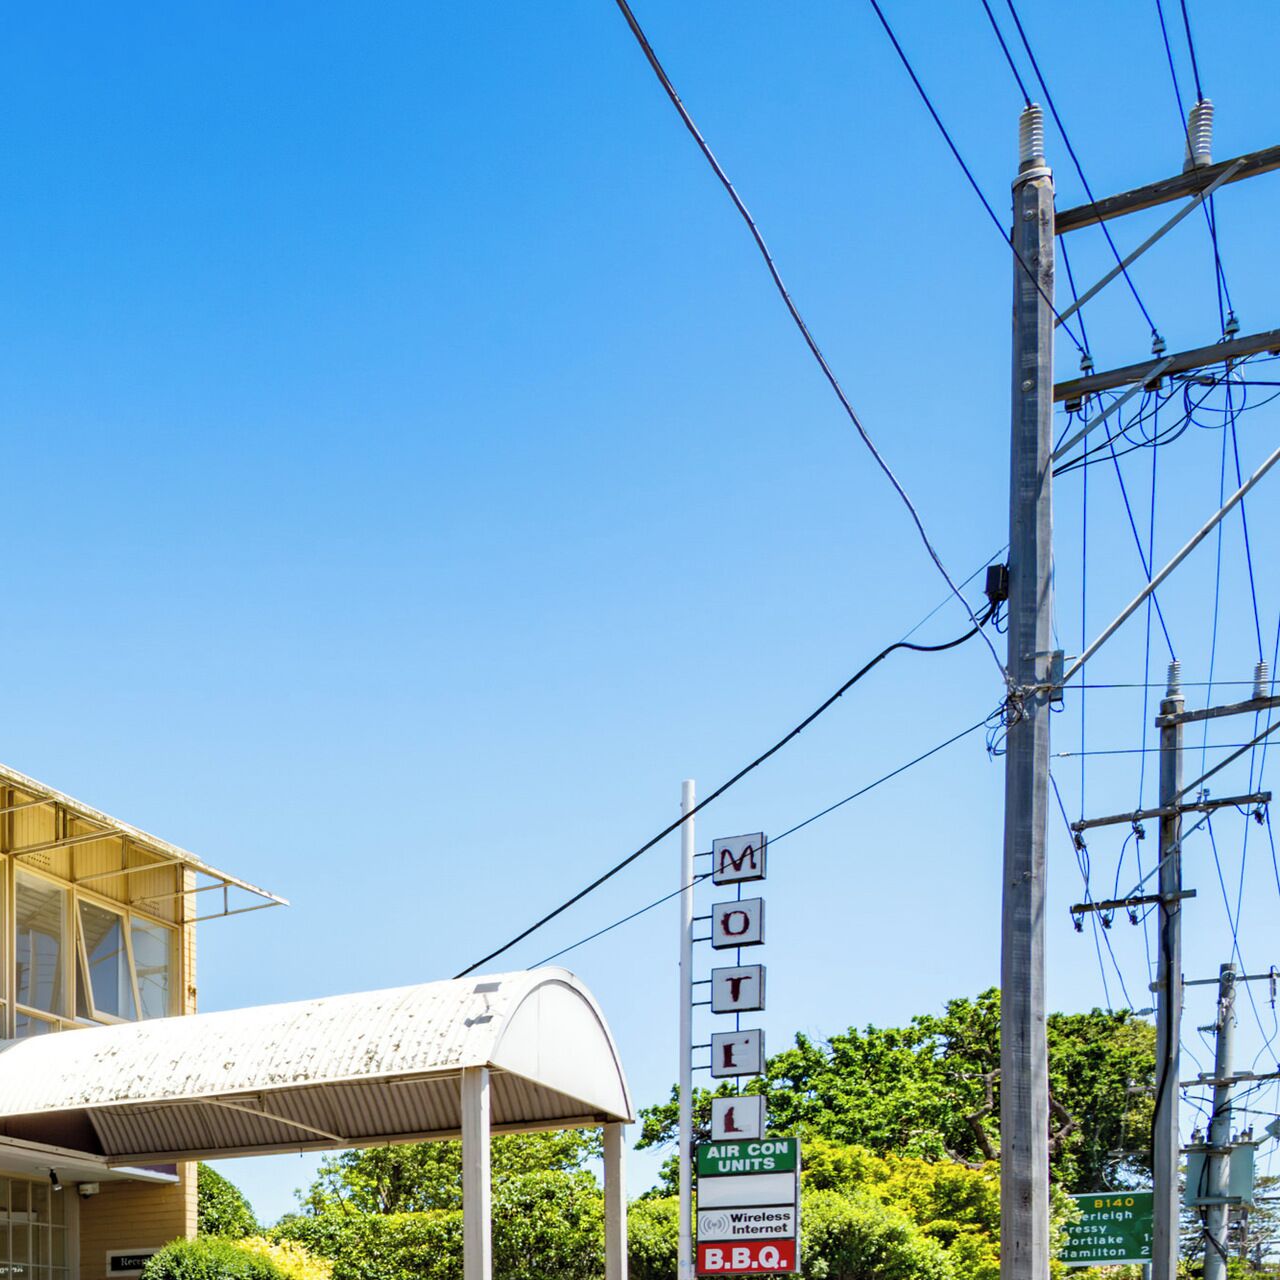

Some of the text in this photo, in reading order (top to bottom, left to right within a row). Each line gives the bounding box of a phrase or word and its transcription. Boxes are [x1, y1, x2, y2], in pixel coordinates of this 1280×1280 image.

[707, 1141, 788, 1159] AIR CON
[718, 1157, 775, 1172] UNITS
[1094, 1197, 1135, 1209] B140
[730, 1211, 791, 1223] Wireless
[1080, 1210, 1133, 1222] erleigh
[732, 1223, 788, 1235] Internet
[1059, 1224, 1107, 1235] Cressy
[705, 1245, 788, 1270] B.B.Q.
[1059, 1247, 1126, 1258] Hamilton
